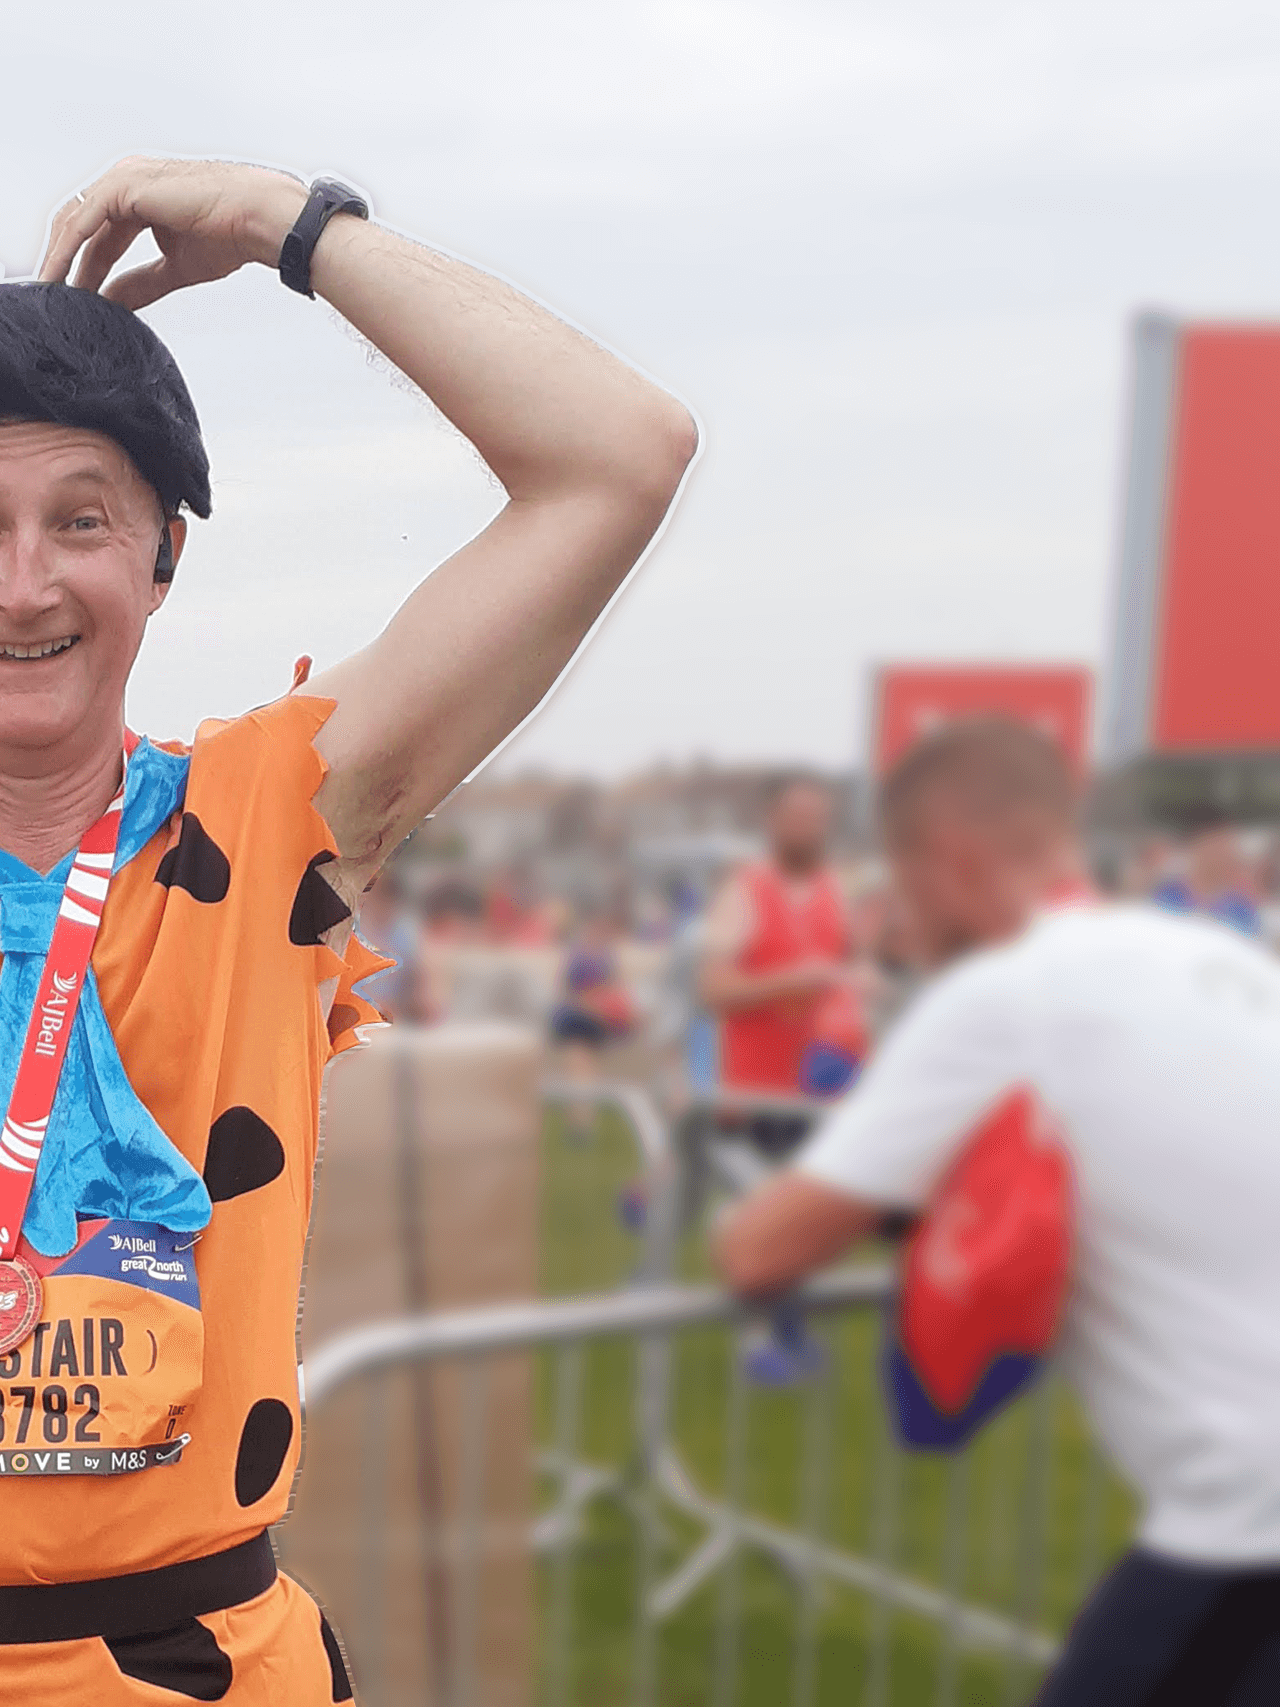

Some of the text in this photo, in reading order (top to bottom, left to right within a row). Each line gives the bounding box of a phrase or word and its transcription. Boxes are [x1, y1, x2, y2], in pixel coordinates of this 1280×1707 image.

[36, 989, 68, 1056] AJBell
[122, 1237, 156, 1253] AJBell
[121, 1259, 184, 1273] great north
[84, 1456, 100, 1469] by
[111, 1449, 147, 1471] M&S
